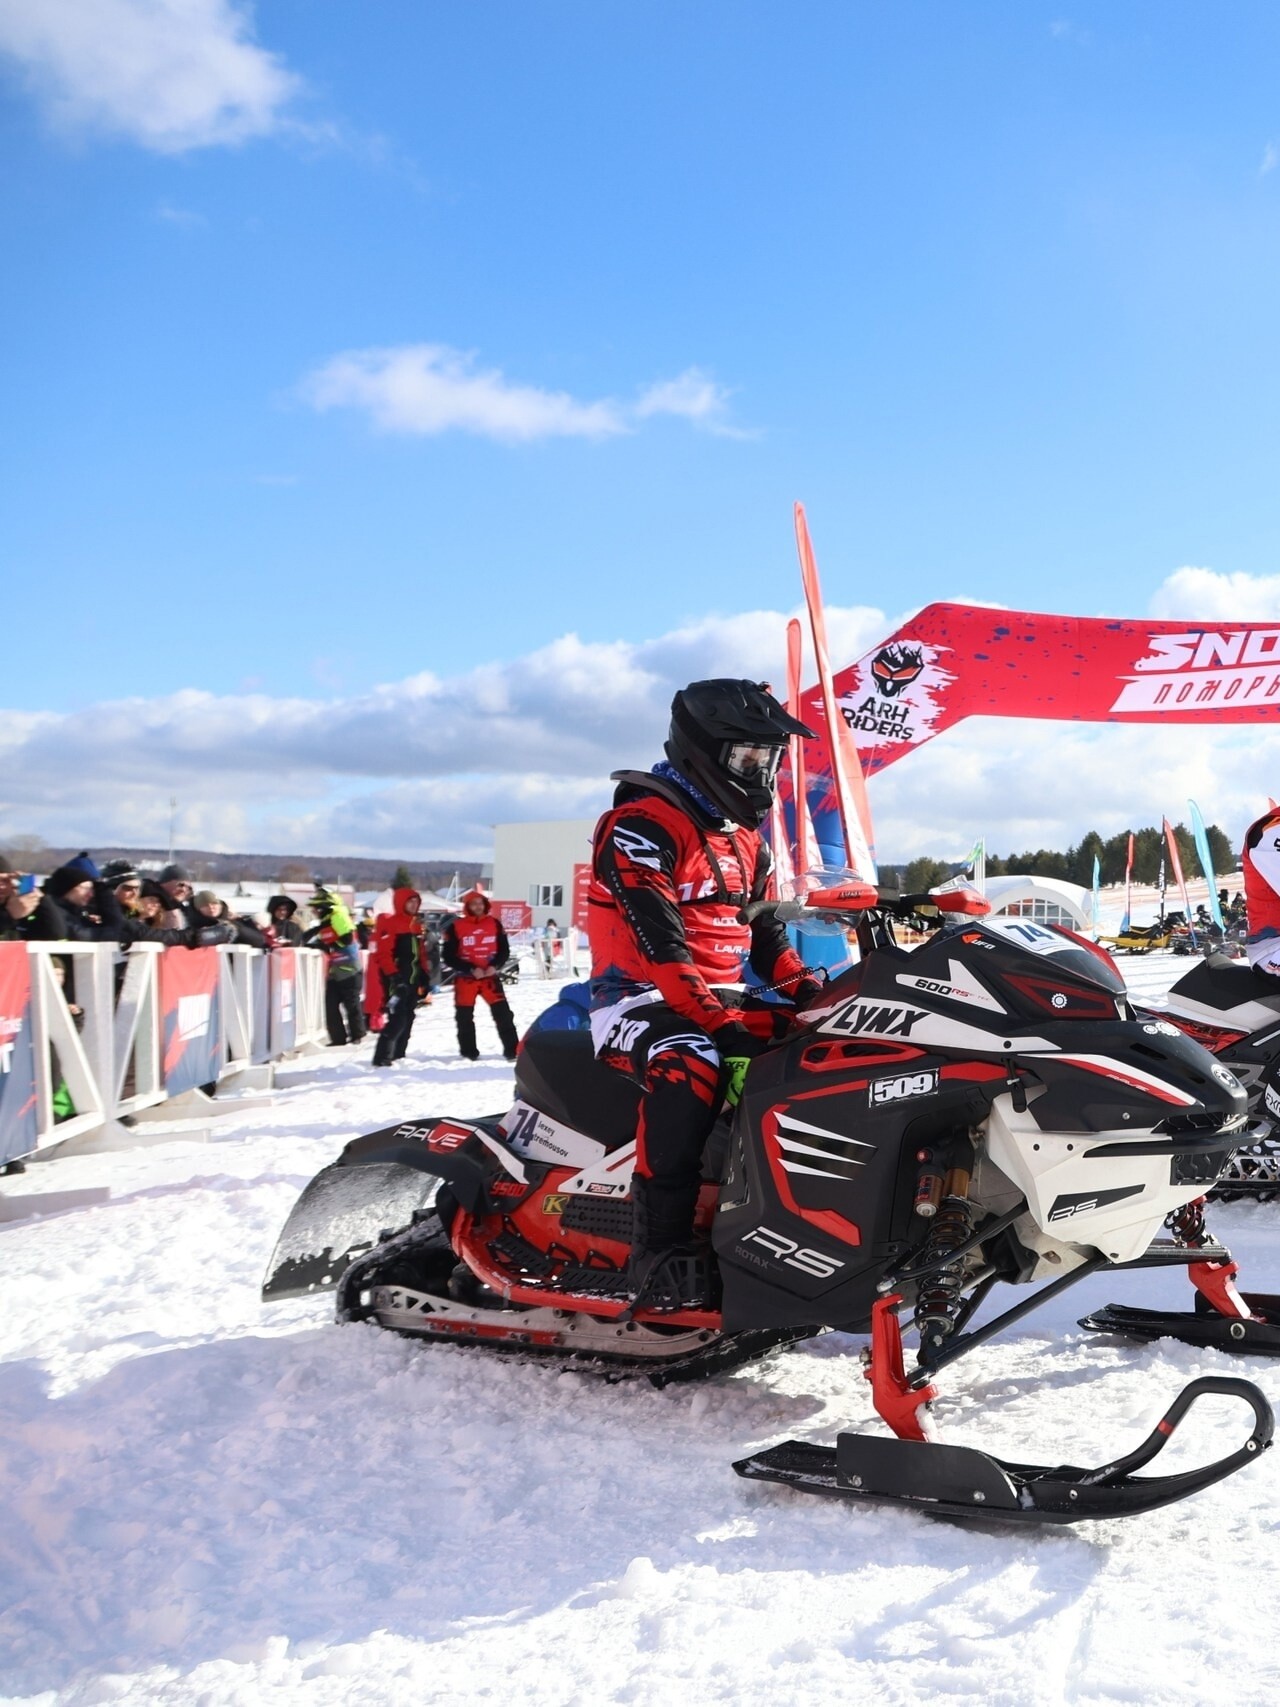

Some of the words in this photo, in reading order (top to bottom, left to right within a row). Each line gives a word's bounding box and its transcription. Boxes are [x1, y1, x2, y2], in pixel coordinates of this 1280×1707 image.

[857, 696, 909, 723] ARH
[841, 707, 915, 740] RIDERS
[971, 939, 996, 950] UFO
[1003, 923, 1056, 943] 74
[714, 943, 744, 954] LAVR
[831, 1003, 933, 1038] LYNX
[604, 1017, 650, 1052] FXR
[873, 1073, 934, 1102] 509
[393, 1124, 468, 1148] RAVE
[506, 1108, 540, 1148] 74
[1049, 1198, 1099, 1223] RS
[734, 1245, 770, 1270] ROTAX
[740, 1226, 846, 1279] RS
